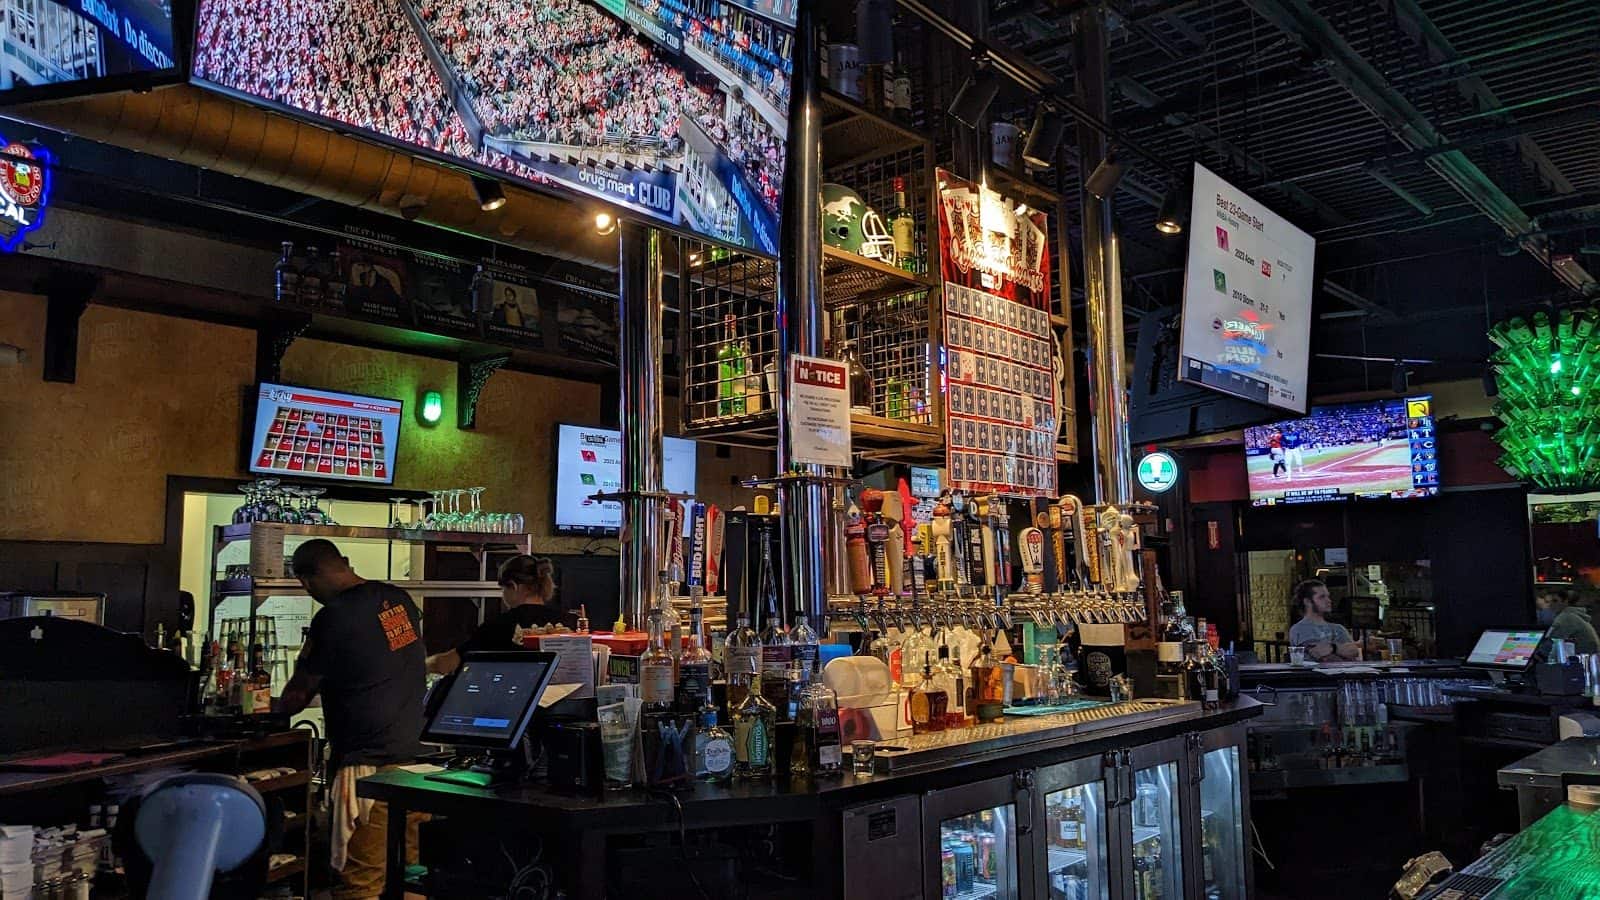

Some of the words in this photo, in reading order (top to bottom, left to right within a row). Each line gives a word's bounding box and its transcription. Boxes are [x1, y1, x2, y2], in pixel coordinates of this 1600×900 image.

[578, 168, 606, 192] drug
[607, 178, 636, 198] mart
[638, 181, 672, 212] CLUB
[1216, 193, 1229, 210] Best
[1253, 215, 1265, 232] Start
[799, 367, 841, 385] NTICE
[694, 516, 706, 552] LIGHT
[692, 552, 703, 579] BUD
[753, 724, 763, 764] HORNITOS
